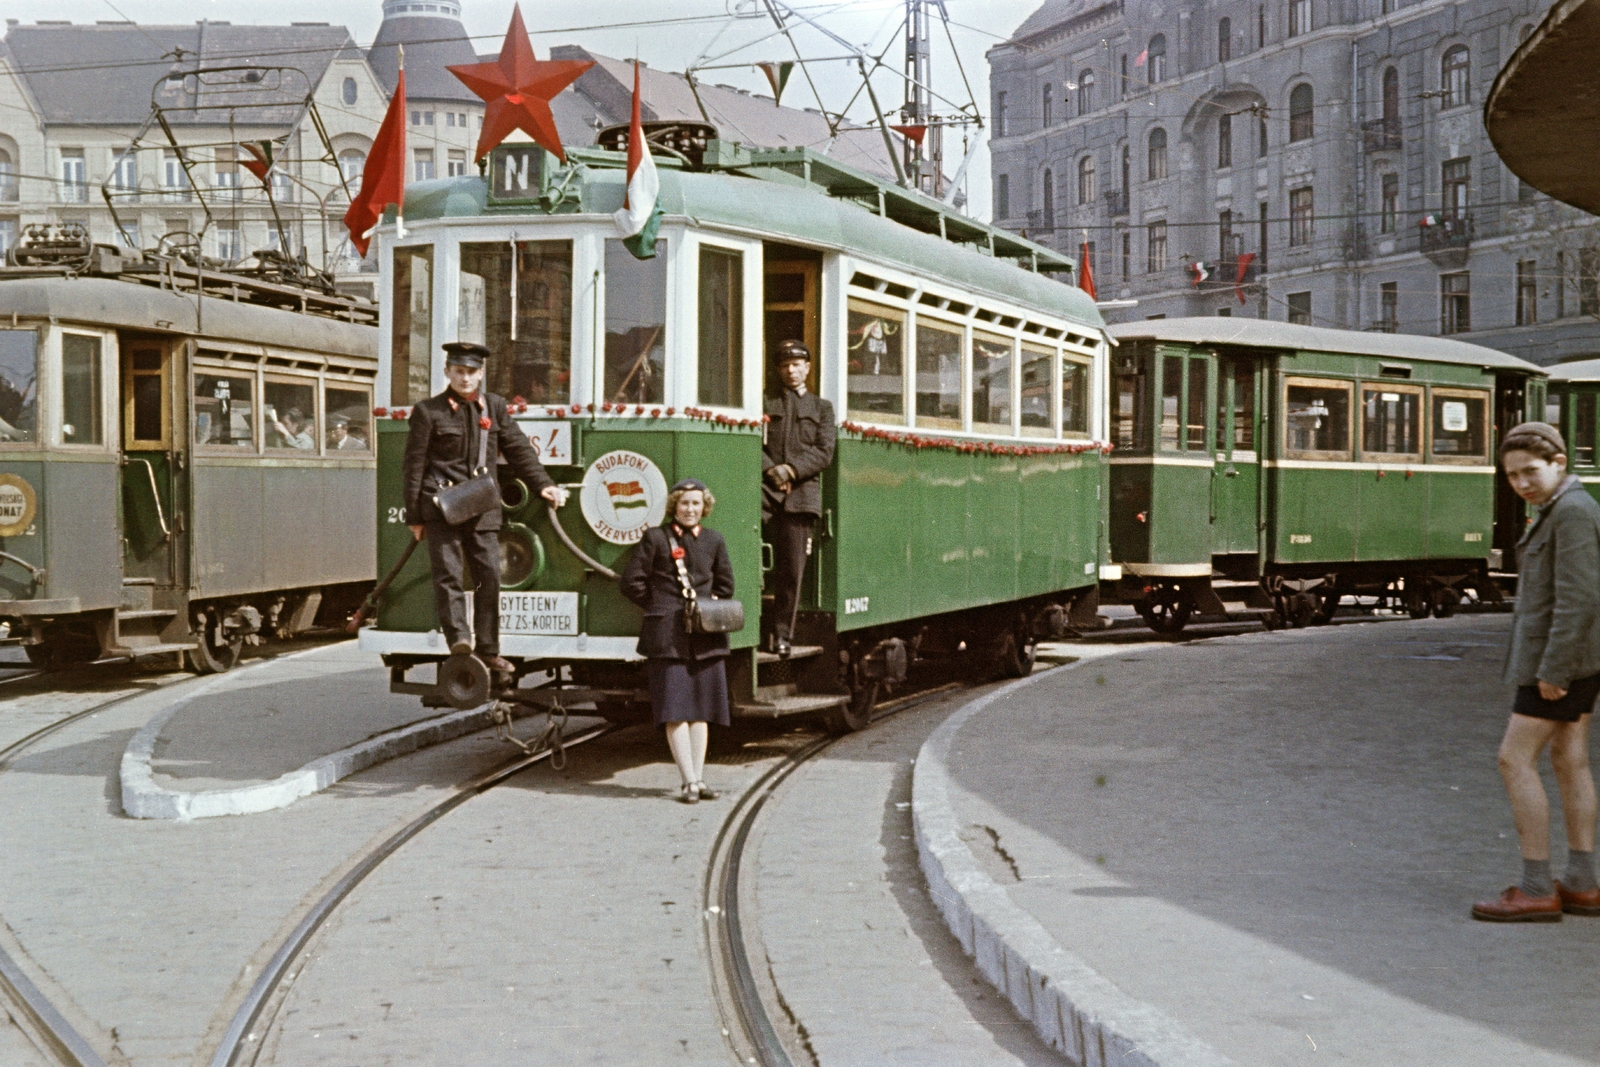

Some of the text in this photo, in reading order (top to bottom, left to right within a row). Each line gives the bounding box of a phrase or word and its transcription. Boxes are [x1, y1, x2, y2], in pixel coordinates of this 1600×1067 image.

[504, 154, 529, 191] N
[595, 453, 649, 474] BUDAFOKI
[0, 506, 22, 517] ONAT
[500, 594, 558, 611] GYTÉTÉNY
